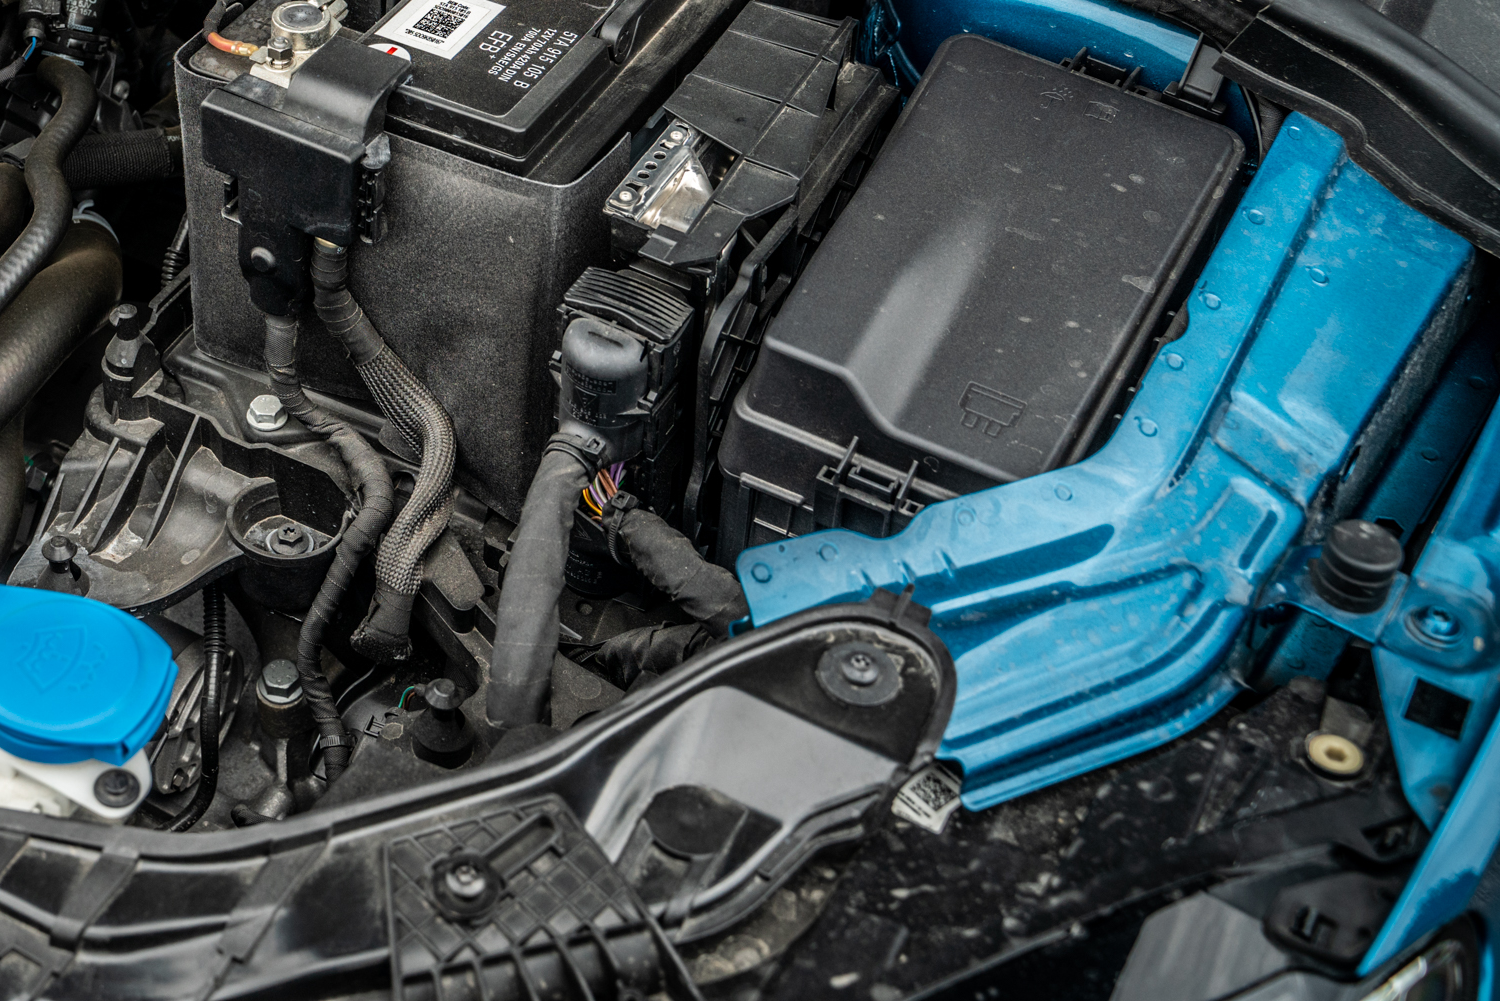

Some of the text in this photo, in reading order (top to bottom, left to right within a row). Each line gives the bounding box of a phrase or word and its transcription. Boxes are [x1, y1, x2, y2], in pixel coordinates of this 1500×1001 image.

[488, 27, 541, 75] 700A EN/SAE/GS
[513, 31, 578, 89] 5TA 915 105 B
